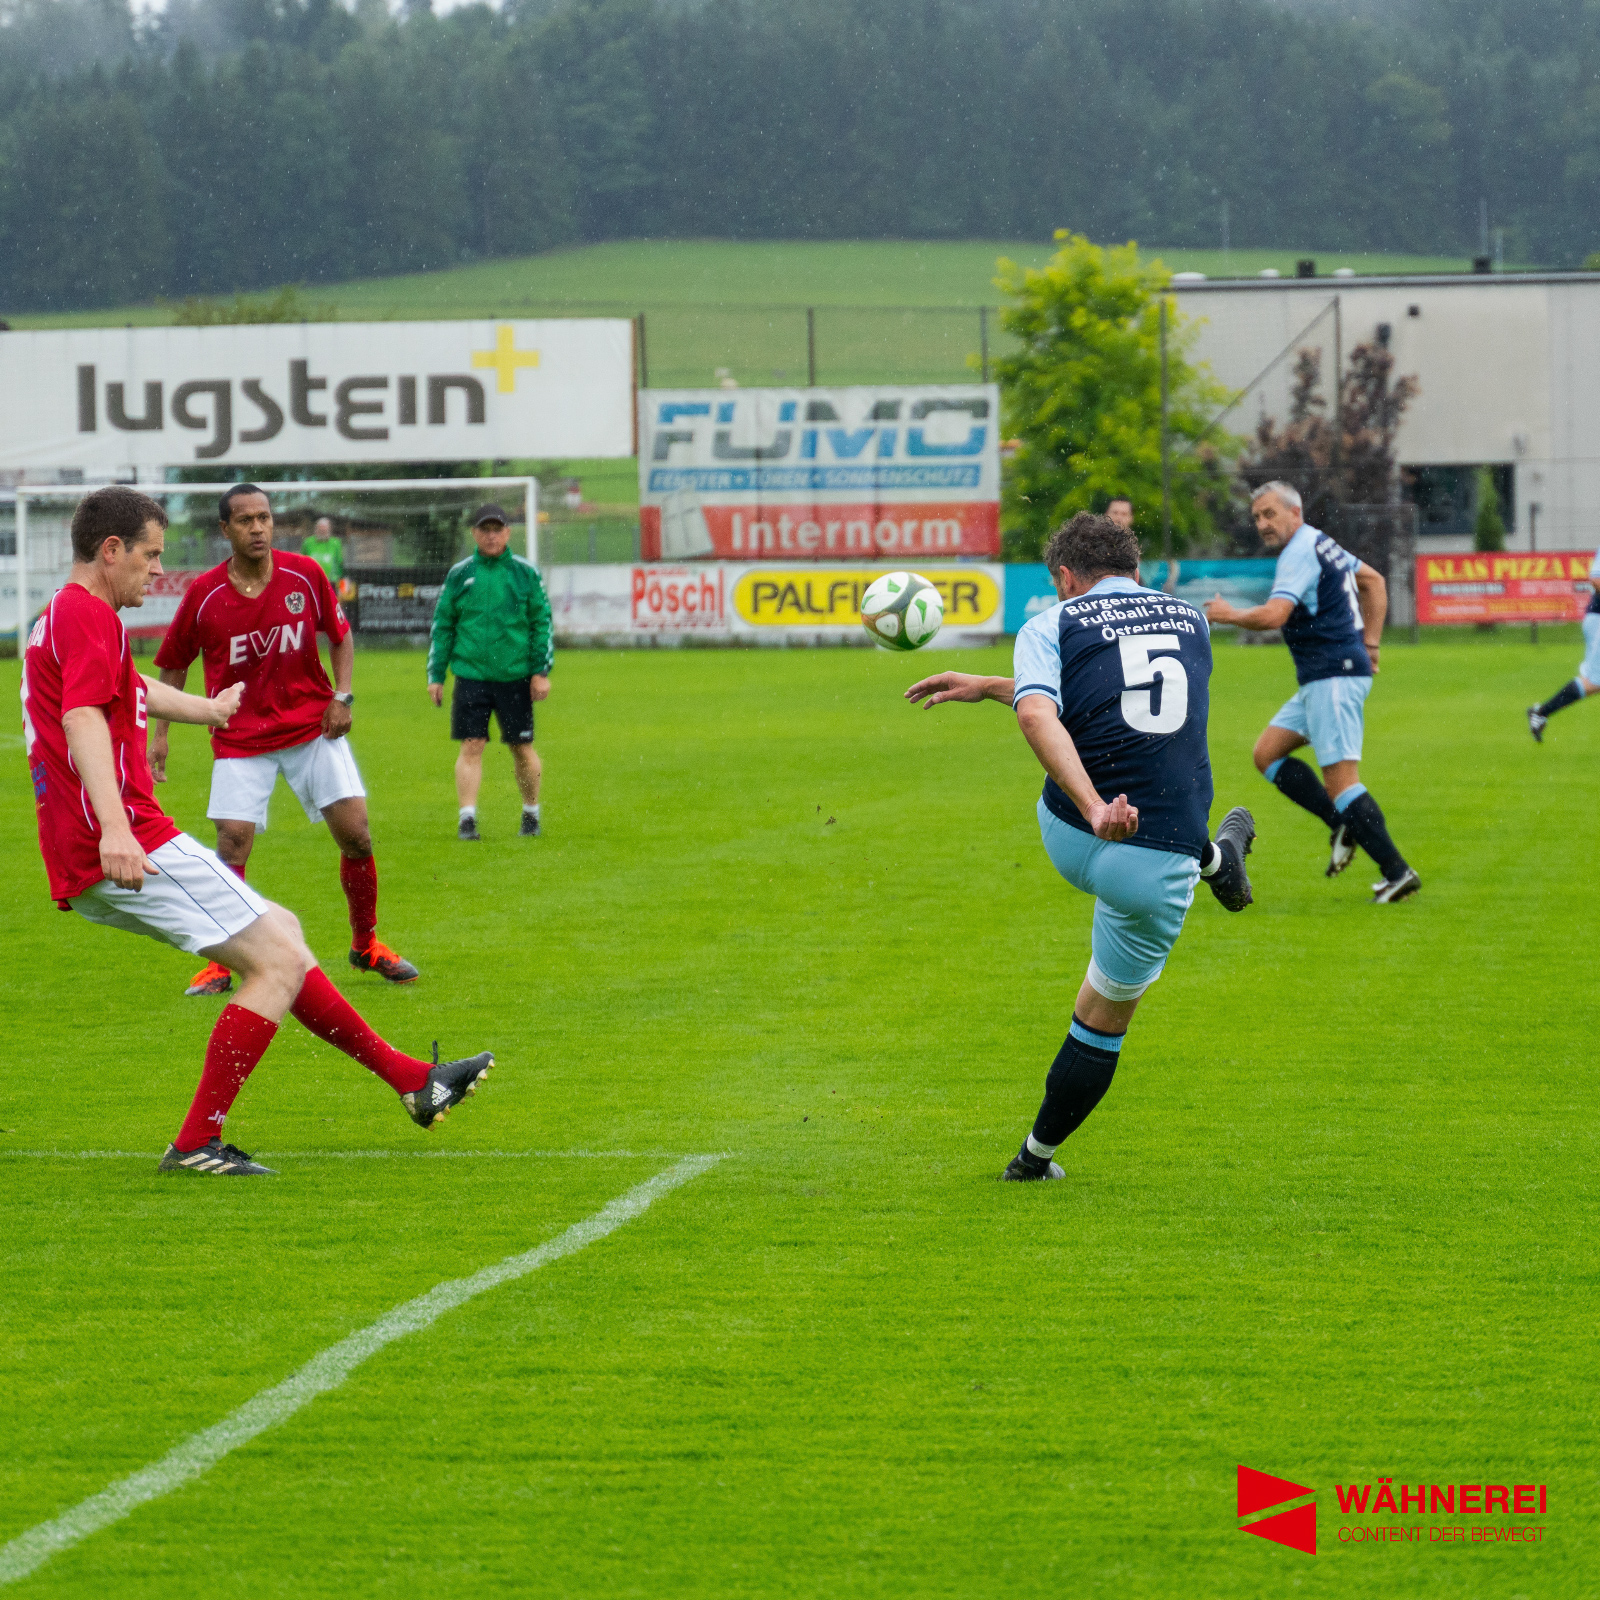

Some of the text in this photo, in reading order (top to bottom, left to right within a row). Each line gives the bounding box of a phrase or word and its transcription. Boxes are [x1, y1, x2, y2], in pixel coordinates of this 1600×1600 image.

[77, 359, 486, 458] lugstein
[652, 399, 990, 462] FUMO
[731, 512, 961, 550] Internorm
[1428, 558, 1489, 581] KLAS
[1494, 557, 1565, 580] PIZZA
[632, 568, 725, 620] Pöschl
[752, 582, 980, 614] PALFIER
[1079, 604, 1200, 627] Fußball-Team
[1102, 618, 1196, 641] Österreich
[229, 620, 304, 665] EVN
[1118, 634, 1189, 734] 5
[432, 1089, 452, 1106] adidas
